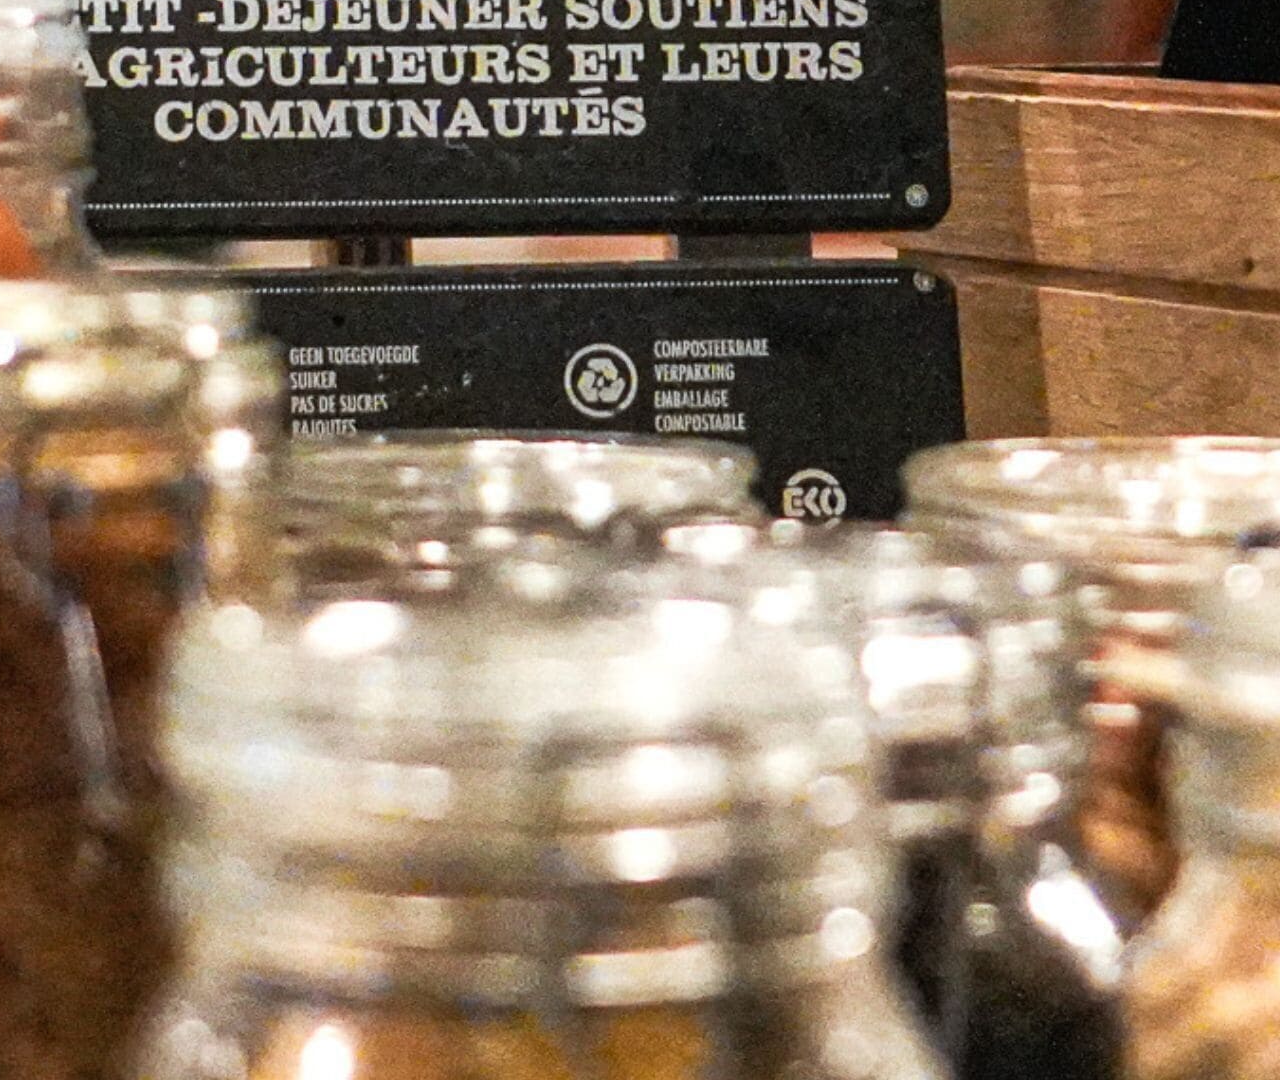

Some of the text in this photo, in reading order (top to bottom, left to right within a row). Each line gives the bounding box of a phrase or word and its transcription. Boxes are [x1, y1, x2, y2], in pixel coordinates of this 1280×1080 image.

[566, 43, 645, 83] ET
[660, 40, 864, 83] LEURS
[153, 86, 647, 142] COMMUNAUTÉS
[289, 344, 420, 366] GEEN TOEGEVOEGDE
[653, 338, 770, 358] COMPOSTEERBARE
[289, 370, 338, 390] SUIKER
[654, 363, 736, 382] VERPAKKING
[291, 393, 389, 414] PAS DE SUCRES
[654, 389, 729, 409] EMBALLAGE
[654, 413, 747, 433] COMPOSTABLE
[782, 486, 847, 517] EKO
